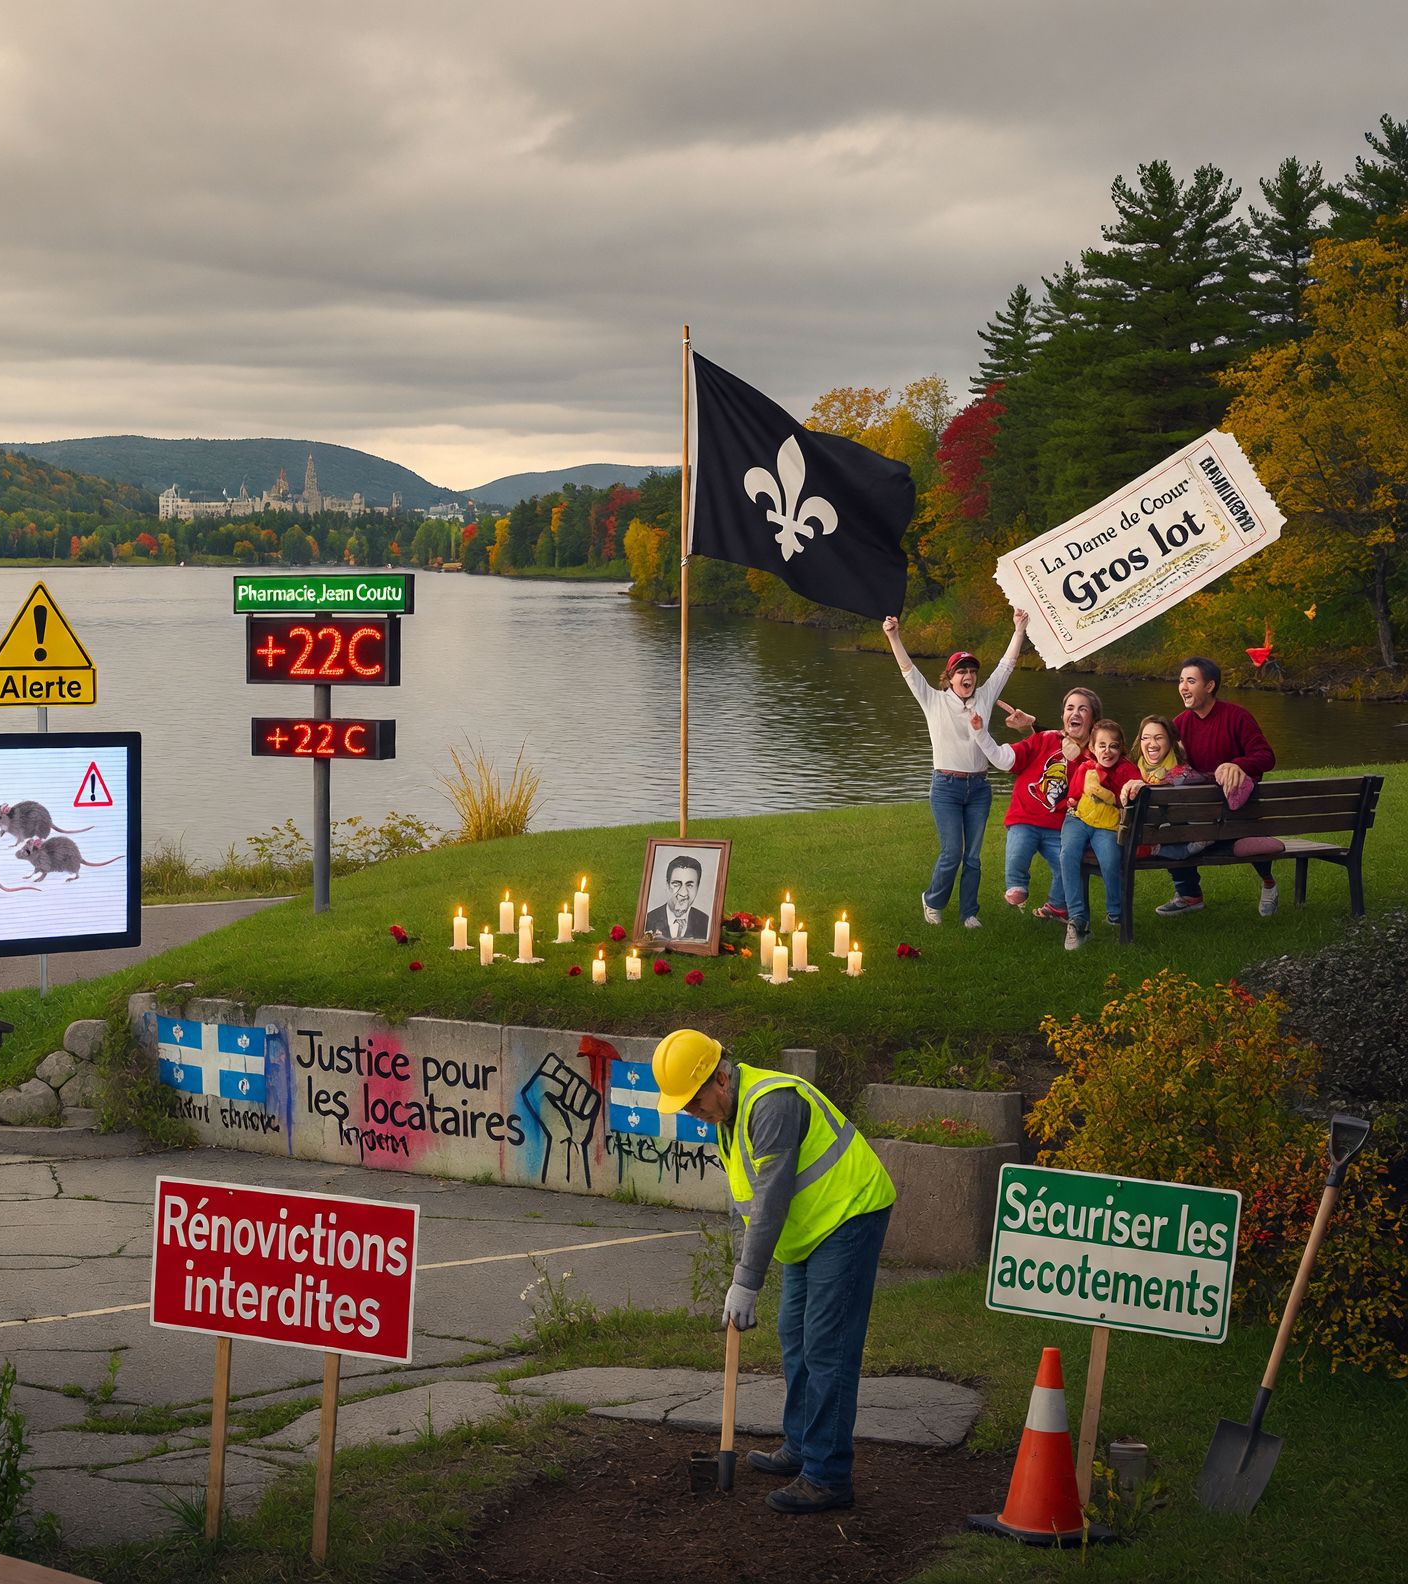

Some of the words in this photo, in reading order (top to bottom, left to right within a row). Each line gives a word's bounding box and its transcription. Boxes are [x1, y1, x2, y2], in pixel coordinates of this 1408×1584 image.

[1040, 557, 1065, 575] La
[1120, 510, 1141, 531] de
[1062, 546, 1149, 612] Gros
[1148, 510, 1206, 557] lot
[256, 627, 381, 676] +22C
[0, 674, 82, 699] Alerte
[296, 1029, 411, 1082] Justice
[422, 1055, 498, 1097] pour
[307, 1075, 350, 1120] les
[363, 1082, 526, 1146] locataires
[163, 1194, 408, 1277] Rénovictions
[1002, 1182, 1169, 1249] Sécuriser
[1177, 1204, 1229, 1257] les
[184, 1259, 381, 1338] interdites
[997, 1253, 1220, 1318] accotements
